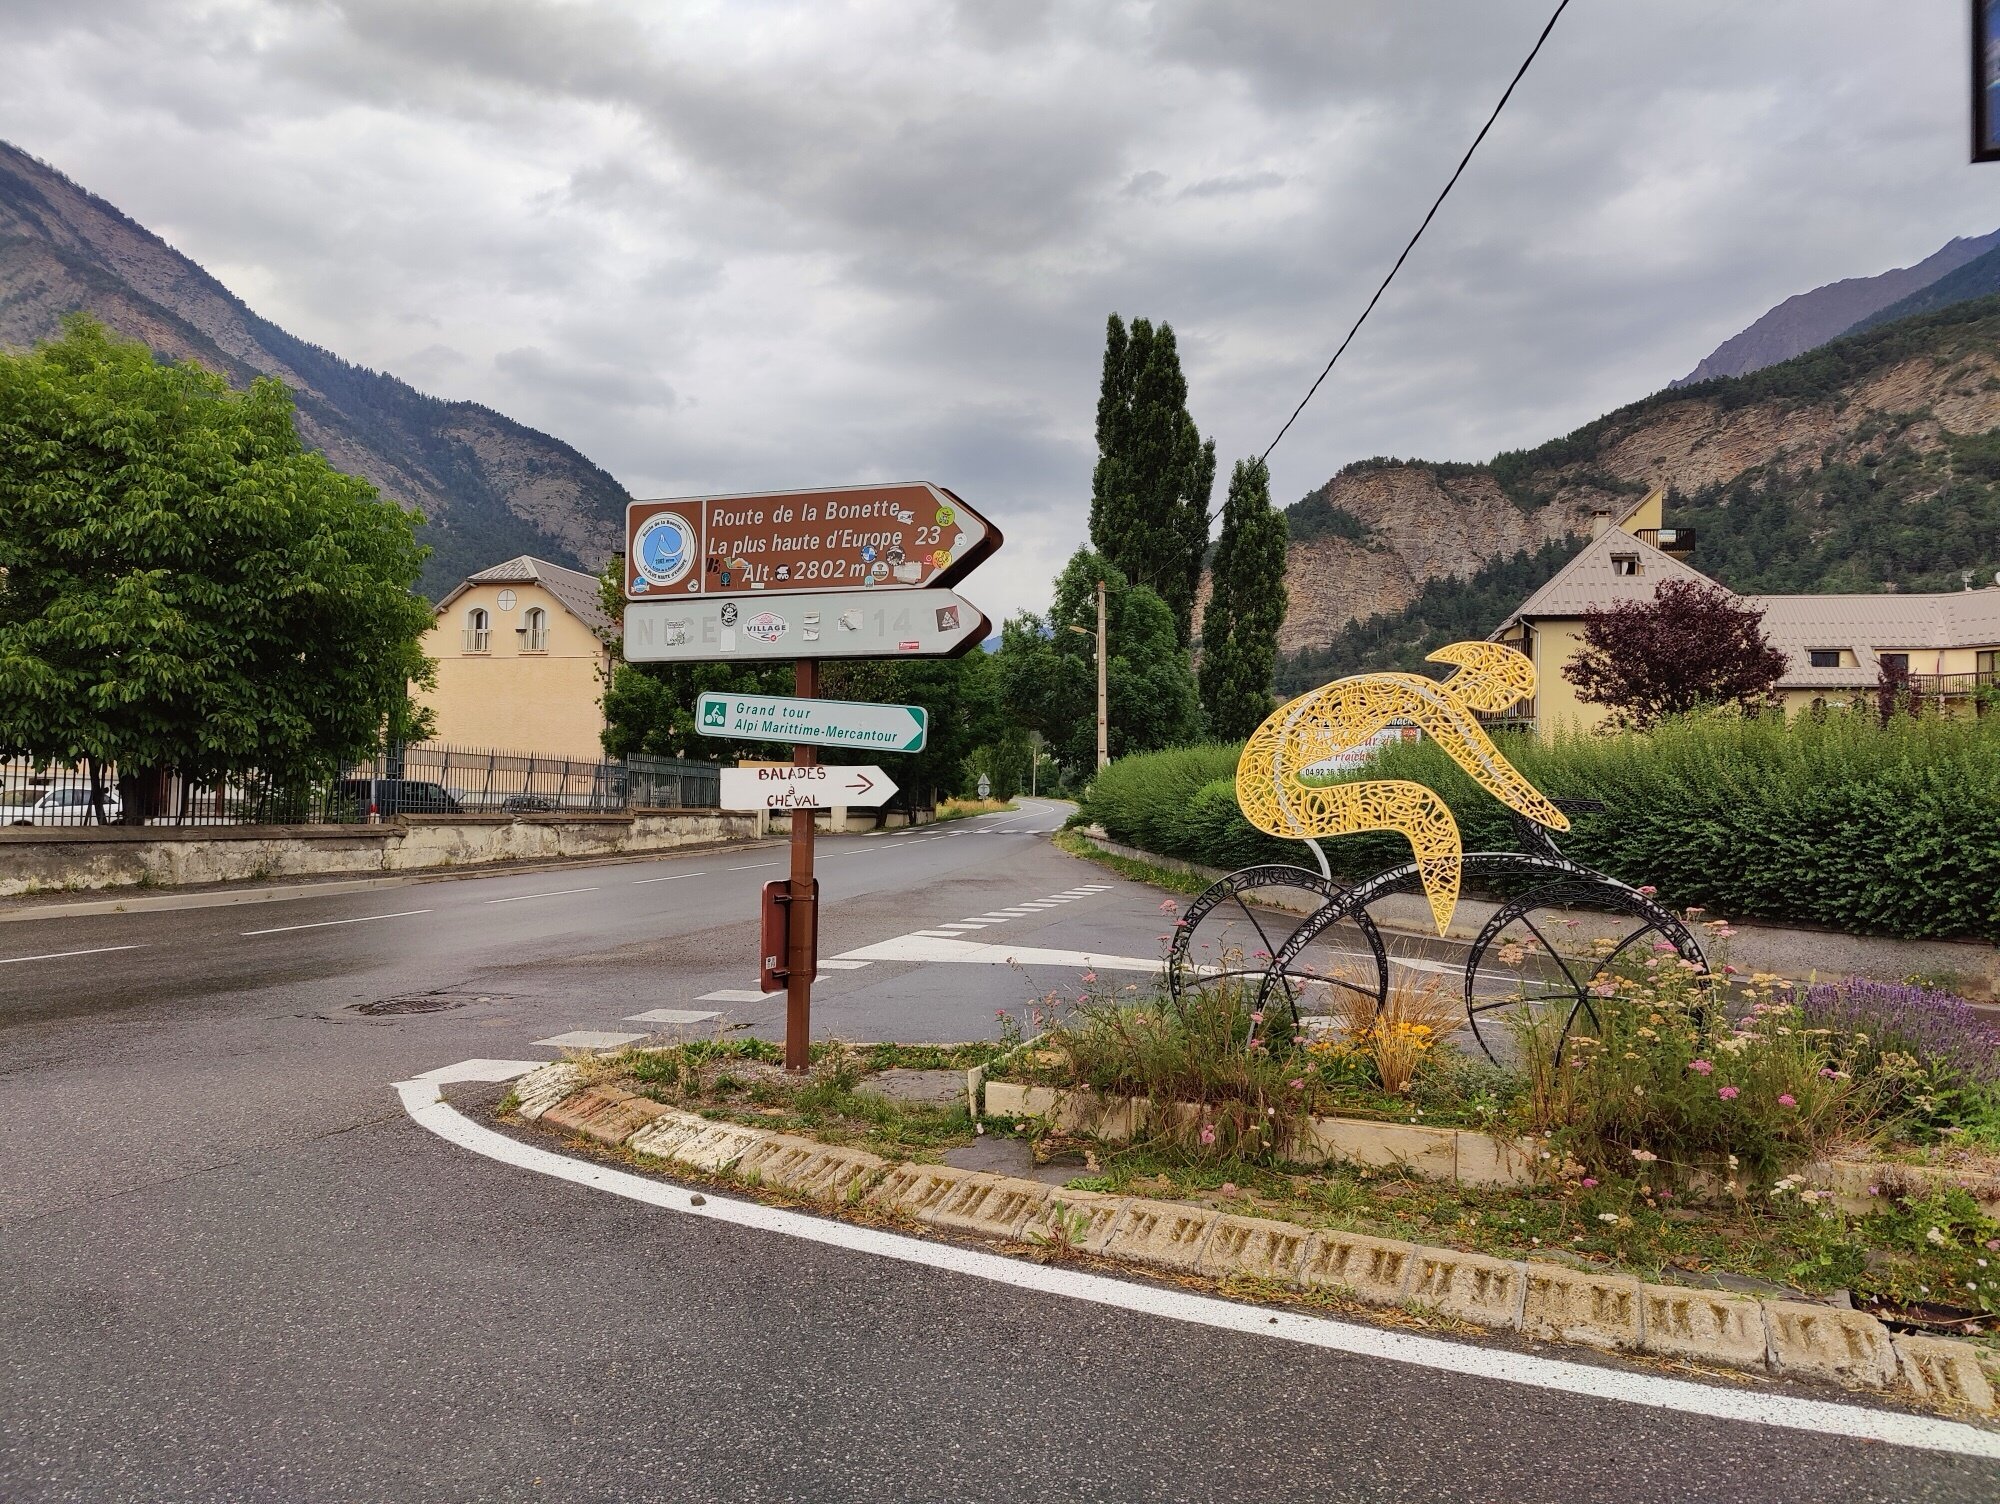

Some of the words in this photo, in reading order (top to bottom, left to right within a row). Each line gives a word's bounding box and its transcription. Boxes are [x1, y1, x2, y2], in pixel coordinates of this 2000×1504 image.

[712, 509, 764, 527] Route
[773, 505, 793, 523] de
[802, 504, 817, 521] la
[825, 500, 900, 520] Bonette
[709, 538, 728, 555] La
[732, 536, 767, 558] plus
[772, 534, 820, 551] haute
[826, 530, 903, 550] d'Europe
[915, 526, 941, 545] 23
[742, 564, 774, 582] Alt.
[794, 559, 846, 580] 2802
[849, 563, 866, 577] m
[736, 702, 776, 716] Grand
[783, 707, 811, 718] tour
[735, 719, 759, 733] Alpi
[761, 721, 898, 742] Marittime-Mercantour
[758, 767, 827, 780] BALADES
[1305, 768, 1314, 776] 04
[1315, 768, 1325, 776] 92
[767, 794, 820, 807] CHEVAL
